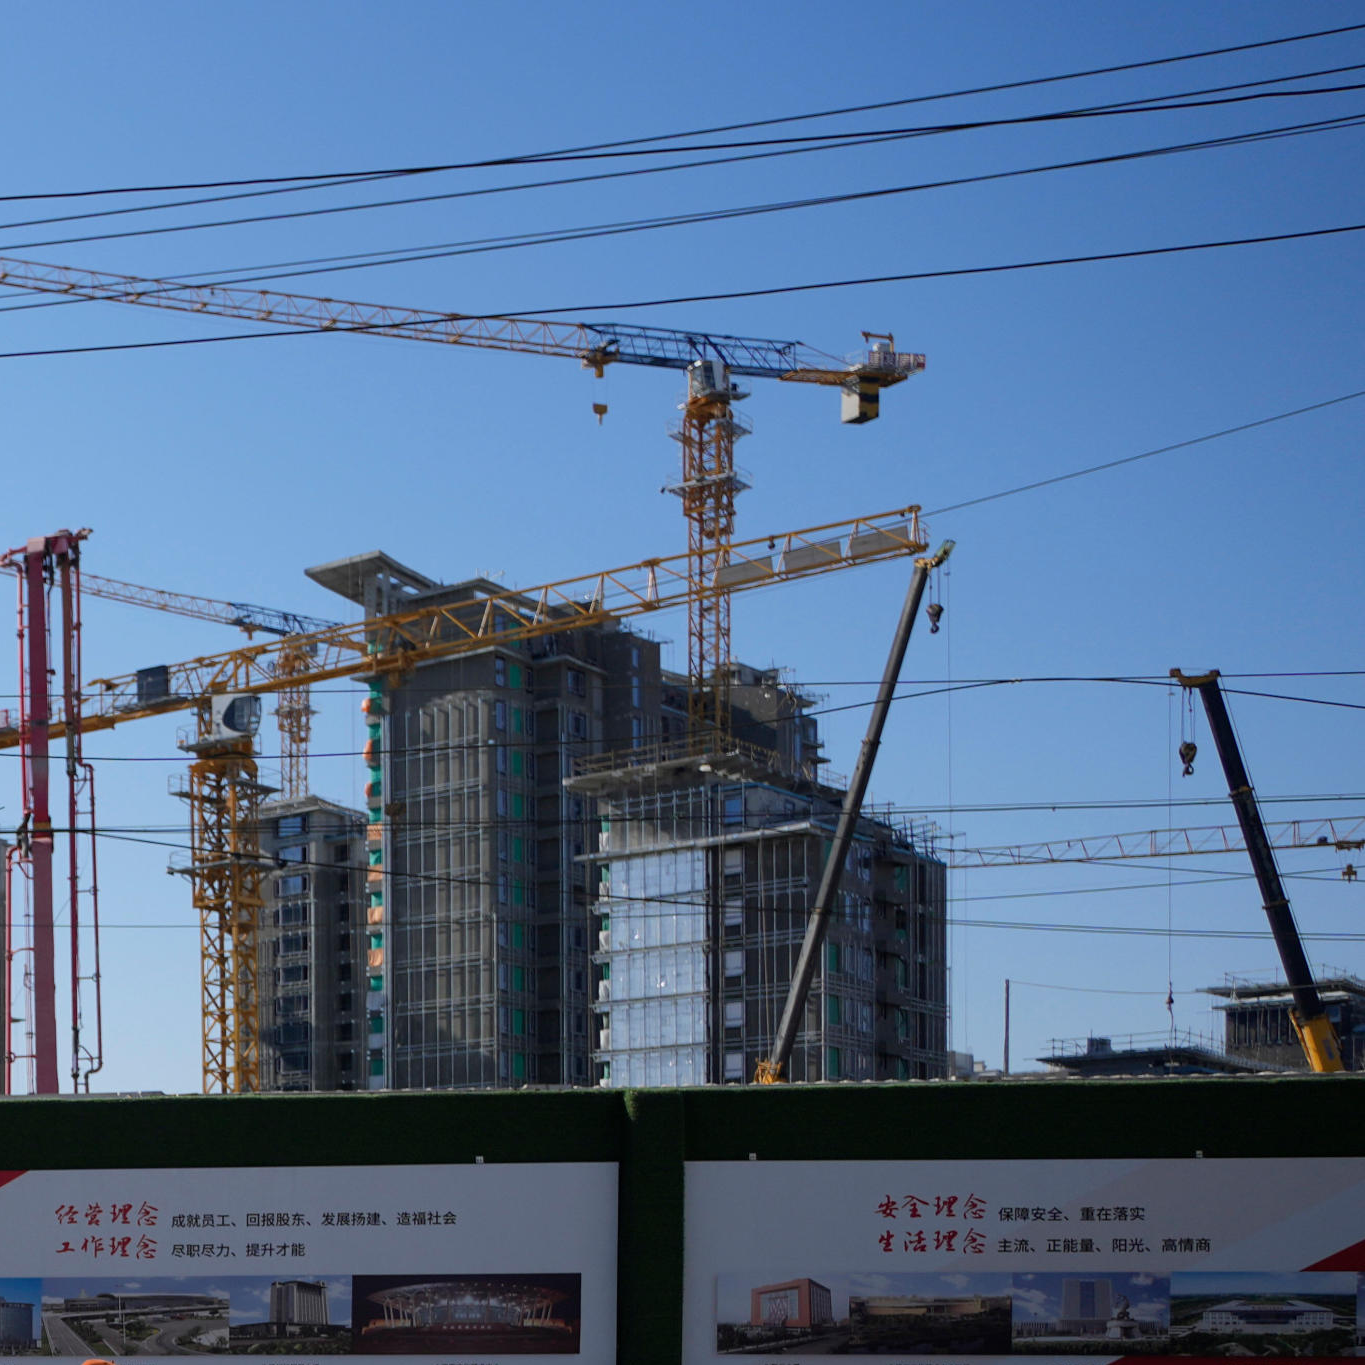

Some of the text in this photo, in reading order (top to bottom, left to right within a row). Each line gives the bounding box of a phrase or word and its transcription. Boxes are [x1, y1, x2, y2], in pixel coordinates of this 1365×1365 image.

[54, 1201, 456, 1229] 经营理念 成就员工、回报股东、发展扬建、造福社会
[874, 1193, 1146, 1222] 安全理念 保障安全、重在落实
[55, 1234, 306, 1260] 工作理念 尽职尽力、提升才能
[877, 1228, 1211, 1255] 生活理念 主流、正能量、阳光、高情商
